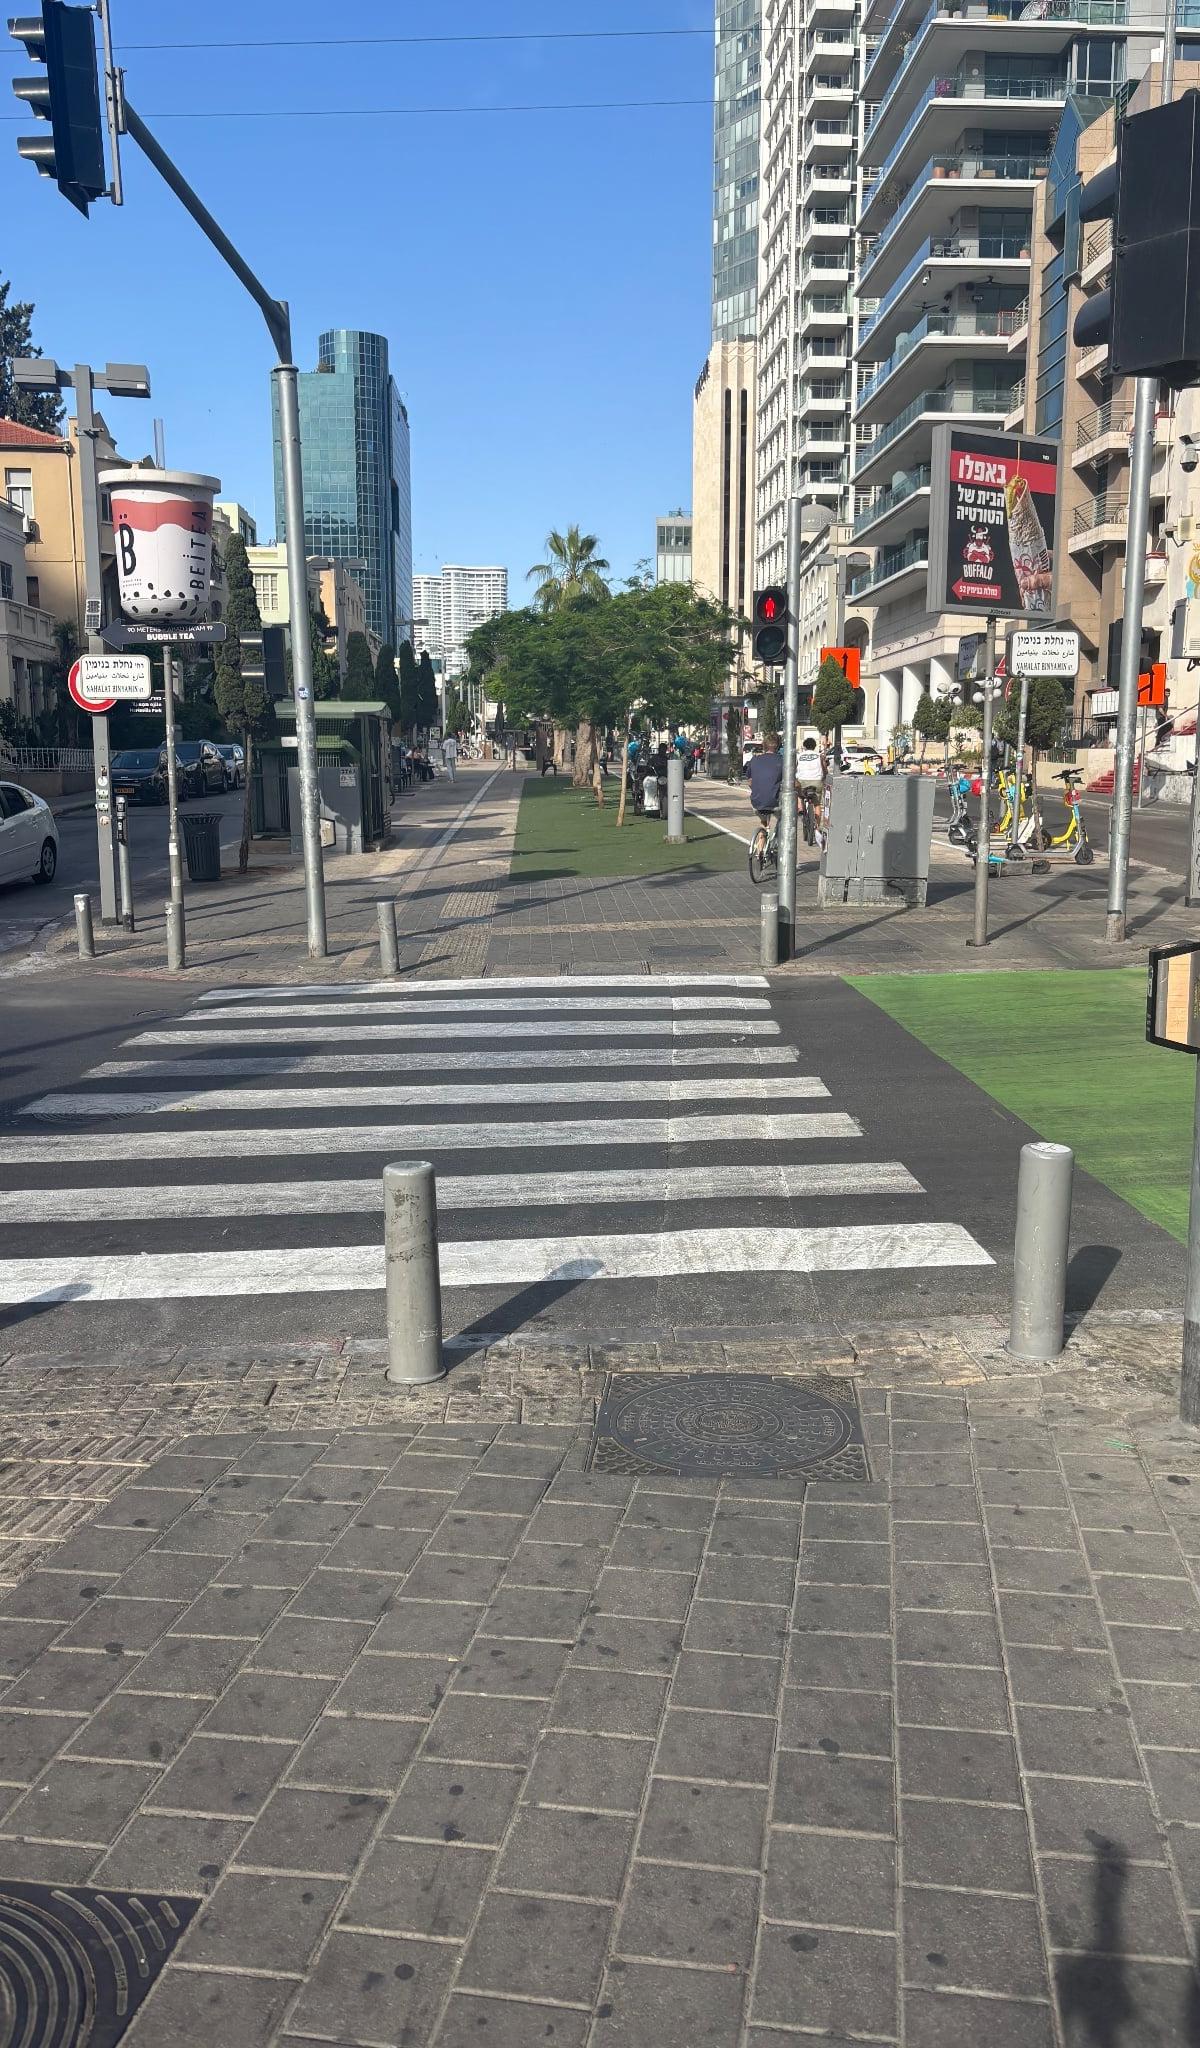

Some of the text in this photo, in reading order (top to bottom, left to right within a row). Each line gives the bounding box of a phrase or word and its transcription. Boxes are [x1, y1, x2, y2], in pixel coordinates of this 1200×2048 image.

[958, 454, 1006, 484] באפלו
[957, 484, 1006, 508] הבית של
[956, 505, 1004, 526] הטורטיה
[962, 564, 993, 581] BUFFALO
[984, 586, 998, 597] נחלת
[1017, 636, 1041, 646] בנימין
[1044, 635, 1064, 645] נחלת
[85, 660, 109, 670] בנימין
[113, 659, 133, 668] נחלת
